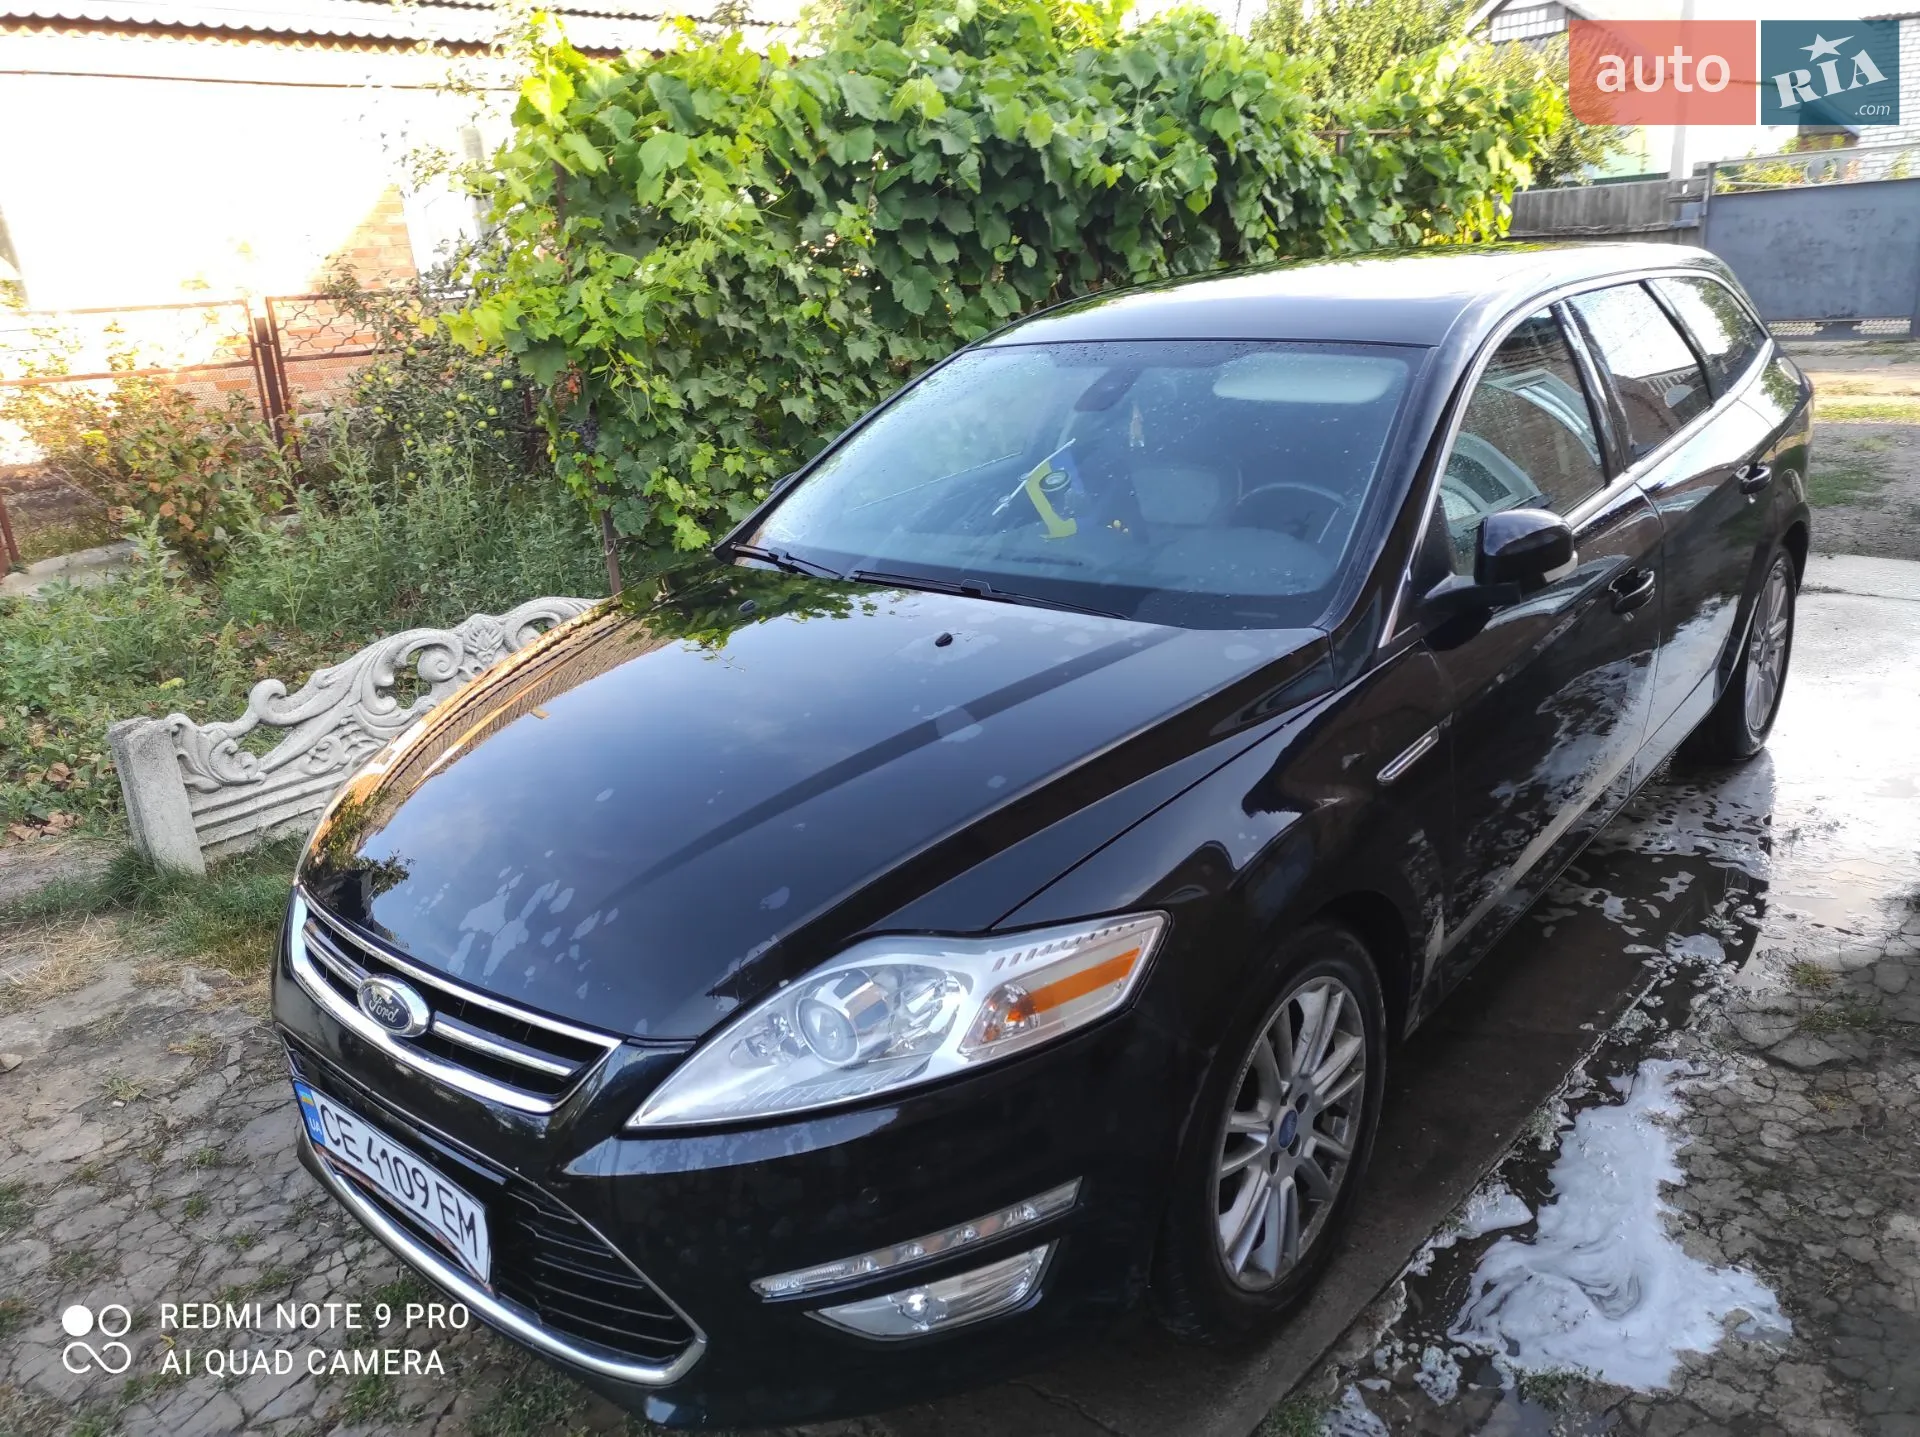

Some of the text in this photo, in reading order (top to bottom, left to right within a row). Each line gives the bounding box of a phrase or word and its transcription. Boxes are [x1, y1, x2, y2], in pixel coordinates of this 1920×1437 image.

[368, 985, 400, 1023] Ford
[308, 1116, 322, 1134] UA
[320, 1103, 479, 1260] CE 4109 EM
